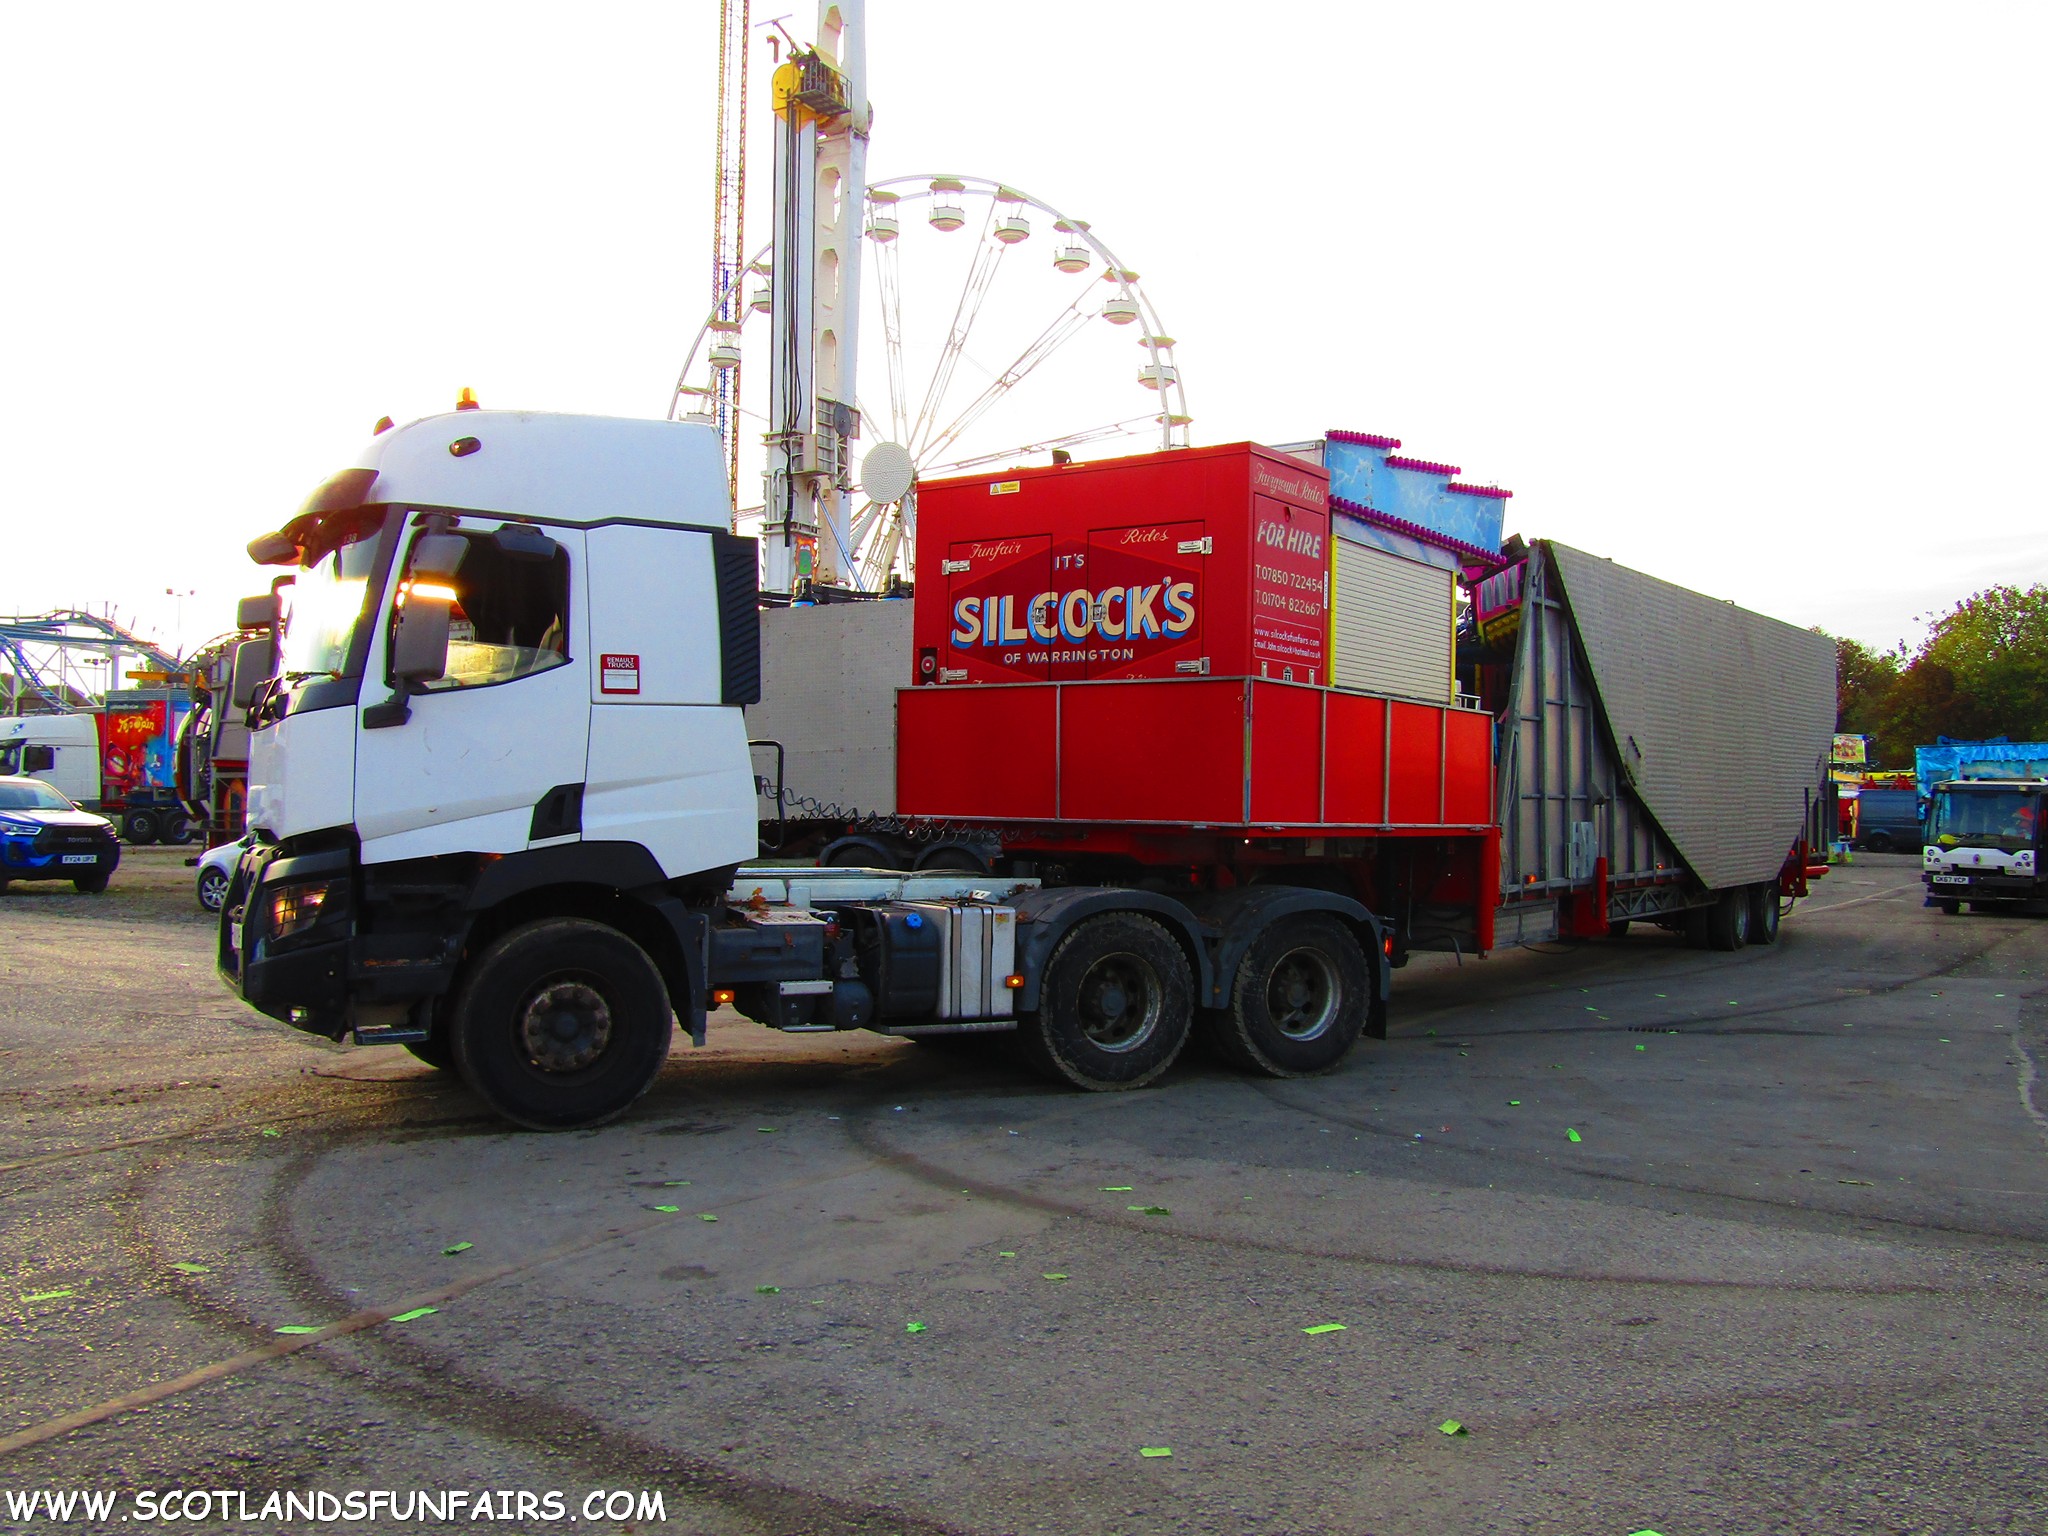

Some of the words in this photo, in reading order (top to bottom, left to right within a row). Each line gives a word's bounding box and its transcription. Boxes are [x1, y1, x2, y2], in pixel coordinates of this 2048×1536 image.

[1300, 480, 1324, 505] Rides
[1121, 528, 1169, 545] Rides
[1257, 519, 1285, 549] FOR
[1287, 527, 1321, 559] HIRE
[968, 541, 1022, 562] Funfair
[1054, 553, 1085, 571] IT'S
[1255, 564, 1288, 585] T.07850
[1290, 573, 1323, 593] 722454
[951, 576, 1196, 649] SILCOCK'S
[1255, 590, 1286, 609] T.01704
[1288, 598, 1321, 617] 822667
[1004, 653, 1021, 665] OF
[1027, 649, 1135, 664] WARRINGTON
